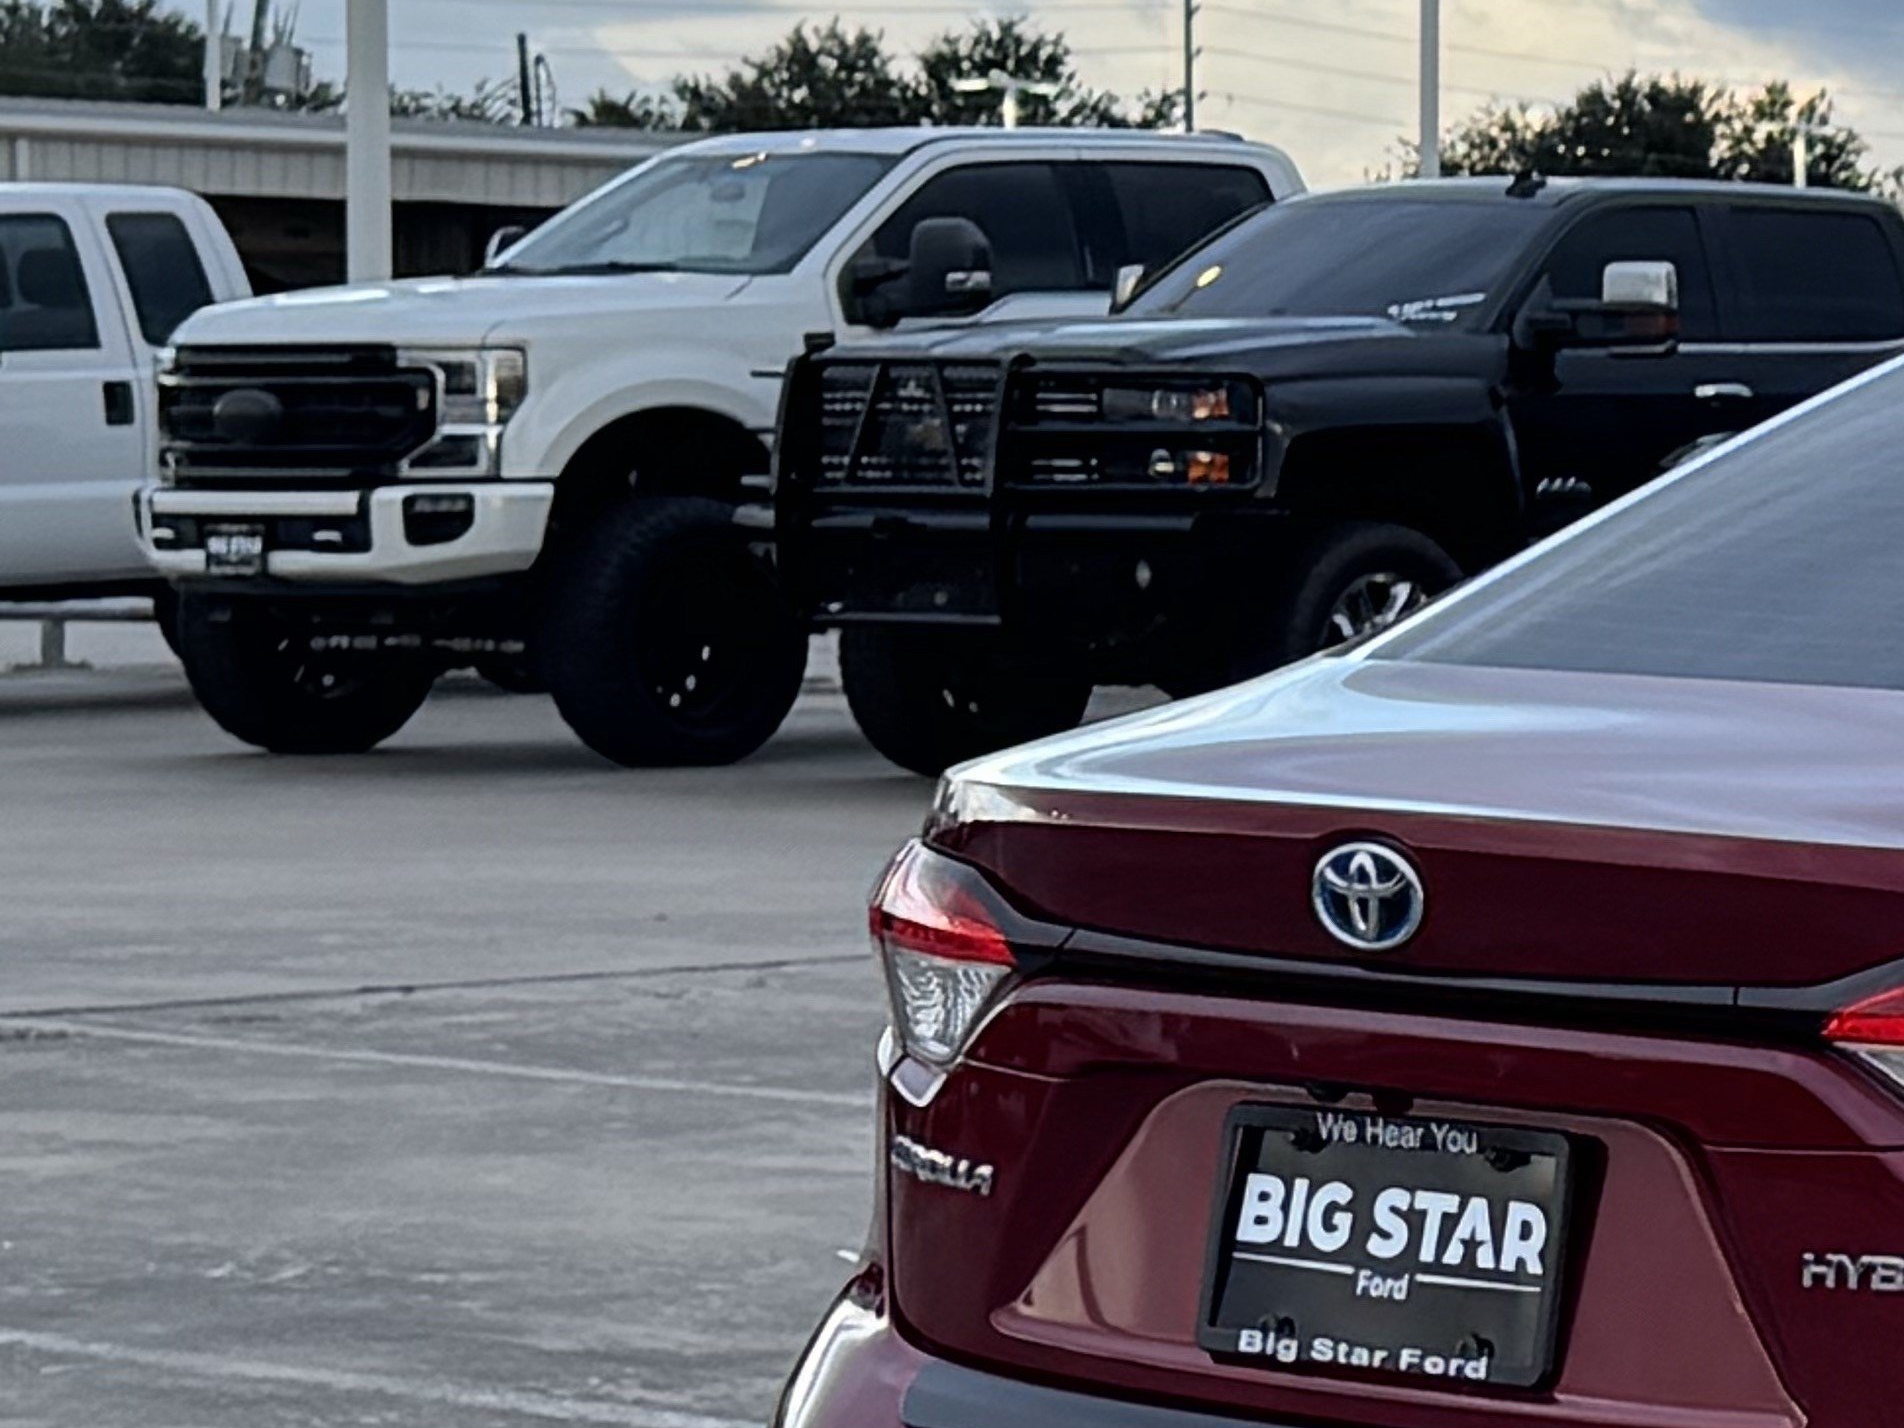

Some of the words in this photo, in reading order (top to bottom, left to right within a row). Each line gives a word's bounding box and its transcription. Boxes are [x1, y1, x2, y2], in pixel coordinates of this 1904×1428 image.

[1316, 1112, 1358, 1143] We
[1365, 1118, 1425, 1150] Hear
[1431, 1123, 1478, 1155] You
[1236, 1172, 1354, 1253] BIG
[1365, 1186, 1547, 1275] STAR
[1355, 1269, 1409, 1301] Ford
[1238, 1329, 1299, 1364] Big
[1310, 1337, 1389, 1369] Star
[1399, 1347, 1488, 1381] Ford
